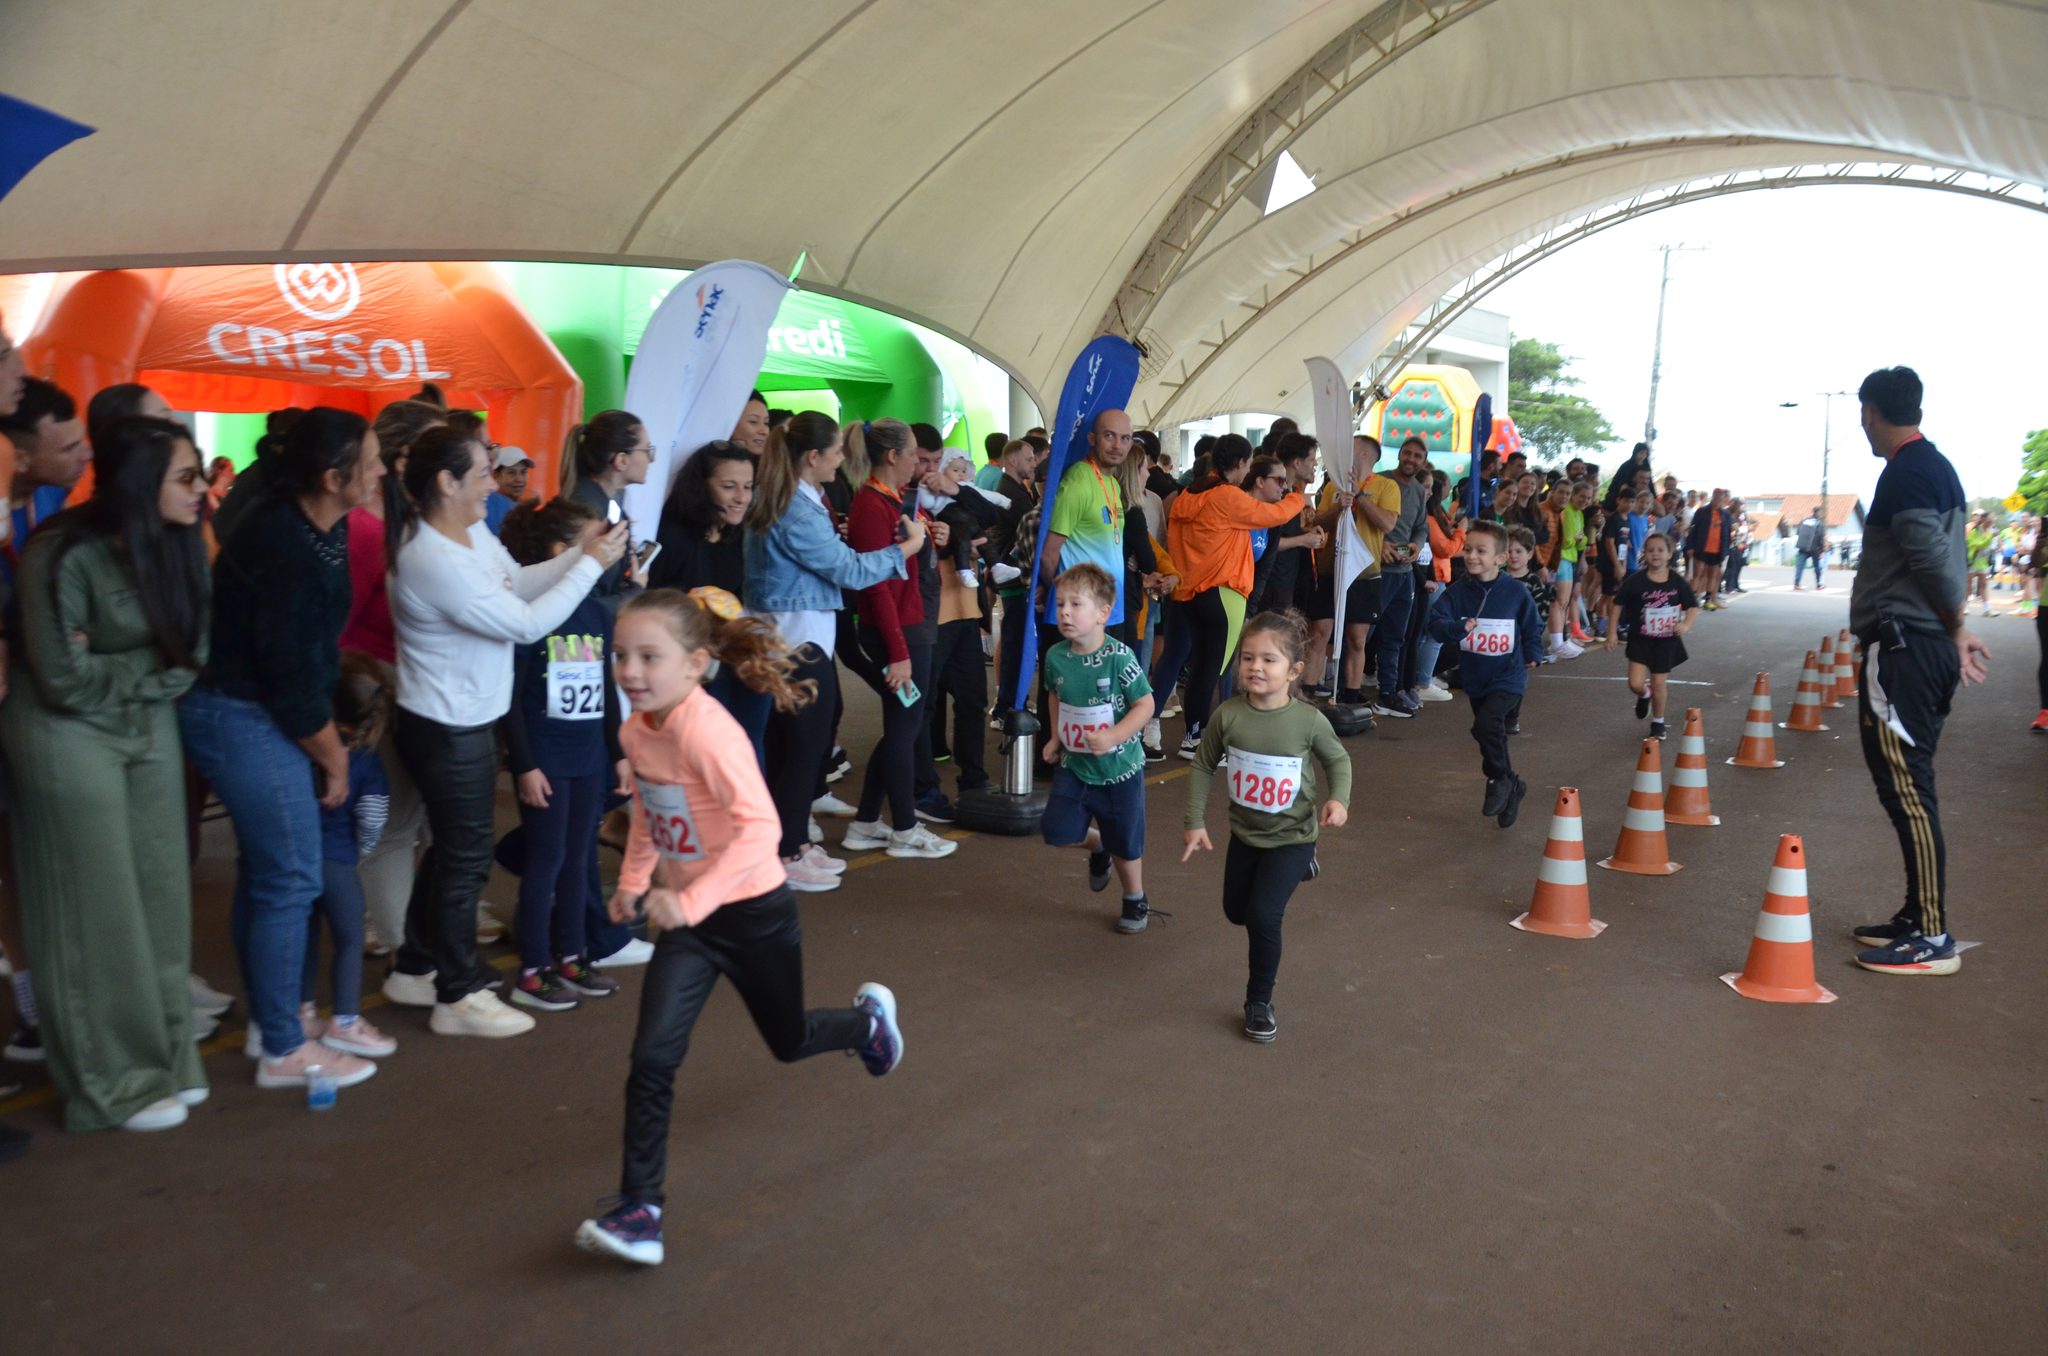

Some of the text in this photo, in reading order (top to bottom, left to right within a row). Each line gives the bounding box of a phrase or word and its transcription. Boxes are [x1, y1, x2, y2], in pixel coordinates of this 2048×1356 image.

[206, 322, 452, 380] CRESOL
[767, 319, 847, 358] redi
[1466, 632, 1510, 653] 1268
[561, 684, 604, 714] 922
[1062, 720, 1110, 749] 12
[1232, 769, 1294, 807] 1286
[644, 808, 697, 854] 62
